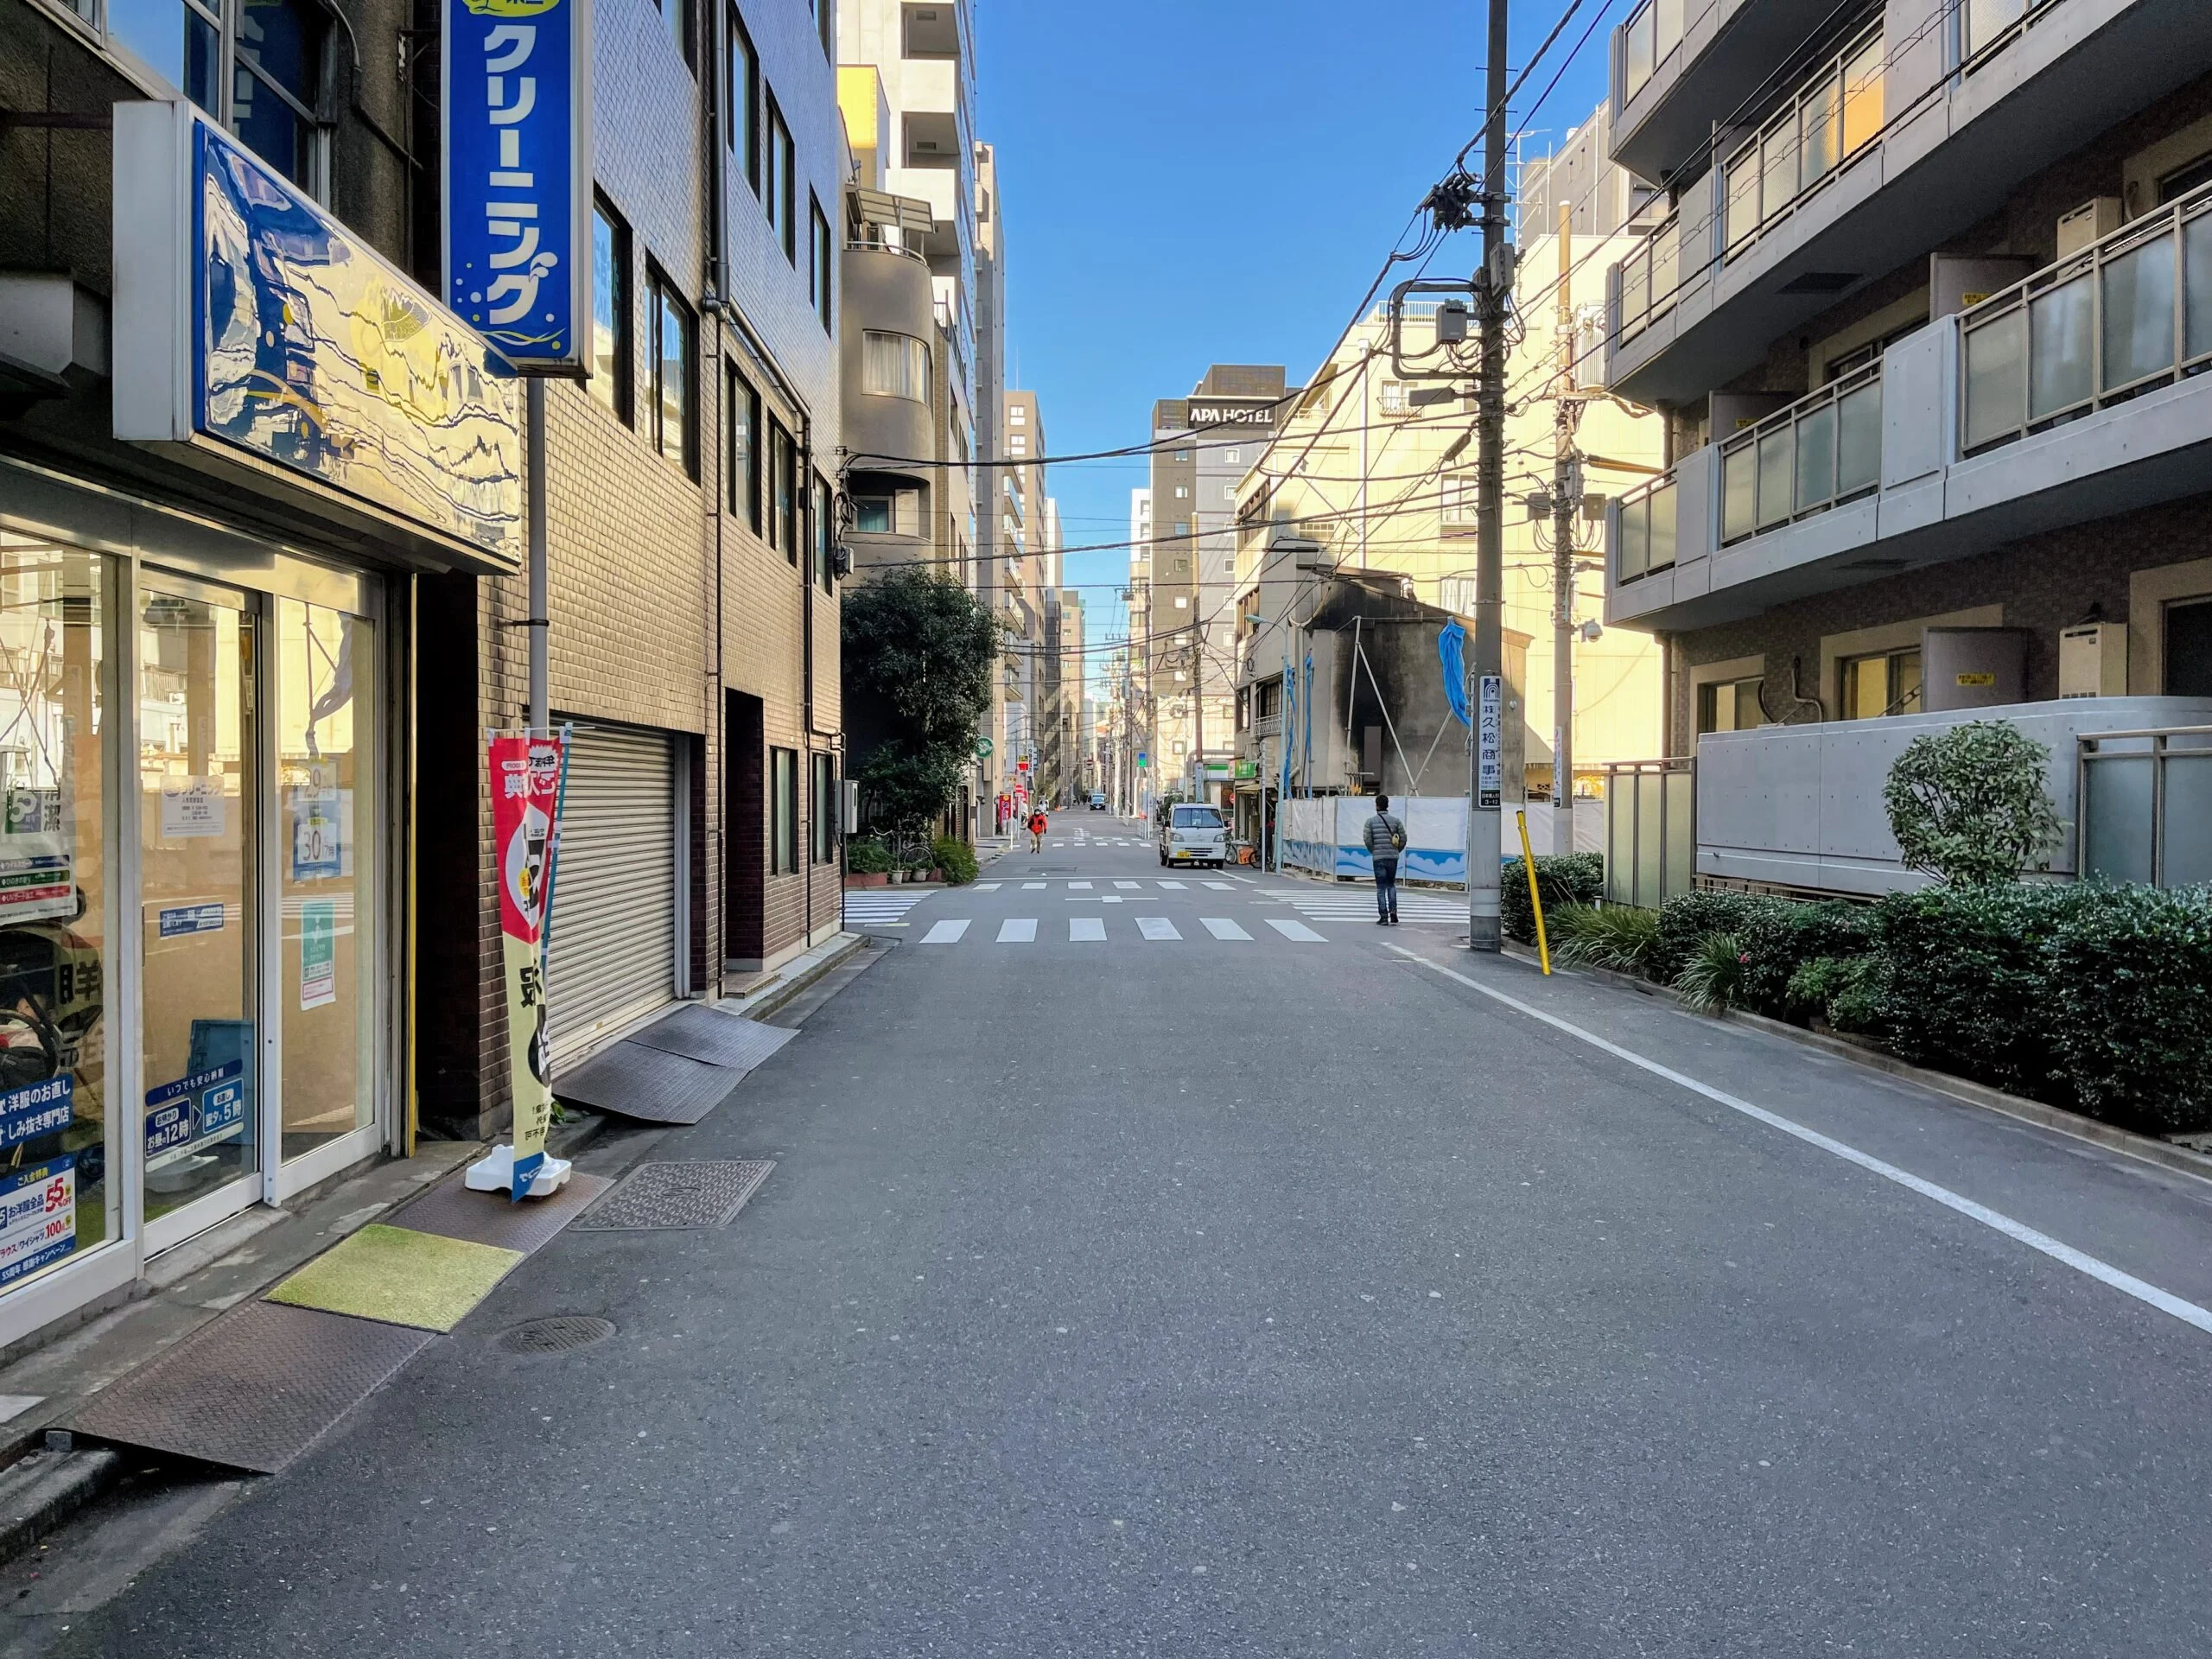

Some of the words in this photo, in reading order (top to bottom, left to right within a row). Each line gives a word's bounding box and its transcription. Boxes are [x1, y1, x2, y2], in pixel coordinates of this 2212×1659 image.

[484, 24, 558, 325] クリーニング
[1190, 408, 1220, 422] APA
[1223, 408, 1273, 423] HOTEL
[8, 1080, 70, 1112] 洋服のお直し
[168, 1067, 224, 1096] いつでも安心納期
[9, 1106, 69, 1140] しみ抜き専門店
[9, 1193, 45, 1219] お洋服全品
[0, 1233, 45, 1259] ラウス/ワイシャツ
